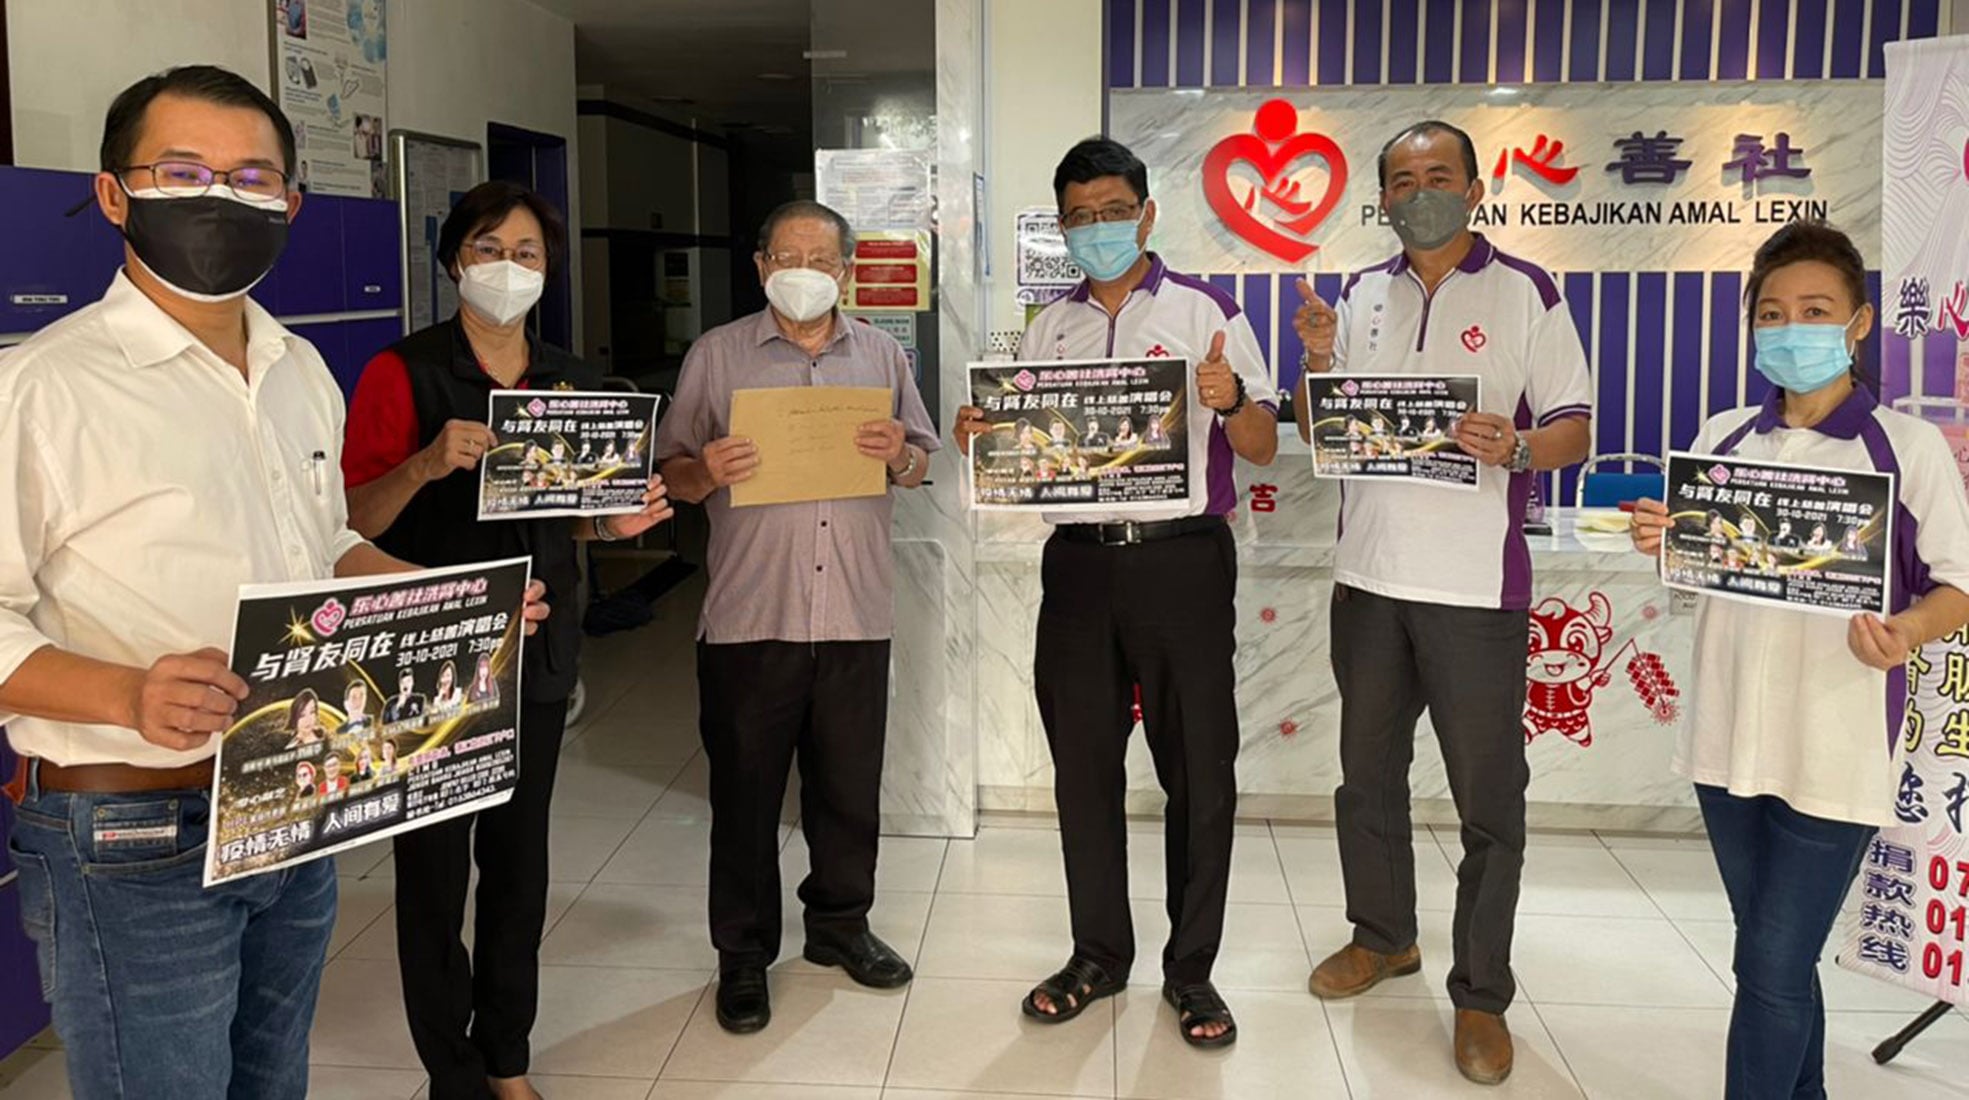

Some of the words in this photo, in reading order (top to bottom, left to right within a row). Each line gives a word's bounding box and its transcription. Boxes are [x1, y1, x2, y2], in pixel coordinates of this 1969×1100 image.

[1521, 202, 1661, 225] KEBAJIKAN
[1669, 201, 1741, 224] AMAL
[1755, 200, 1828, 224] LEXIN
[1249, 483, 1278, 513] 吉
[343, 611, 394, 629] PERSATUAN
[251, 632, 395, 682] 与肾友同在
[396, 643, 458, 667] 30-10-2021
[468, 637, 504, 654] 7:30pm
[323, 793, 399, 834] 人间有爱
[1860, 840, 1914, 971] 捐款热线
